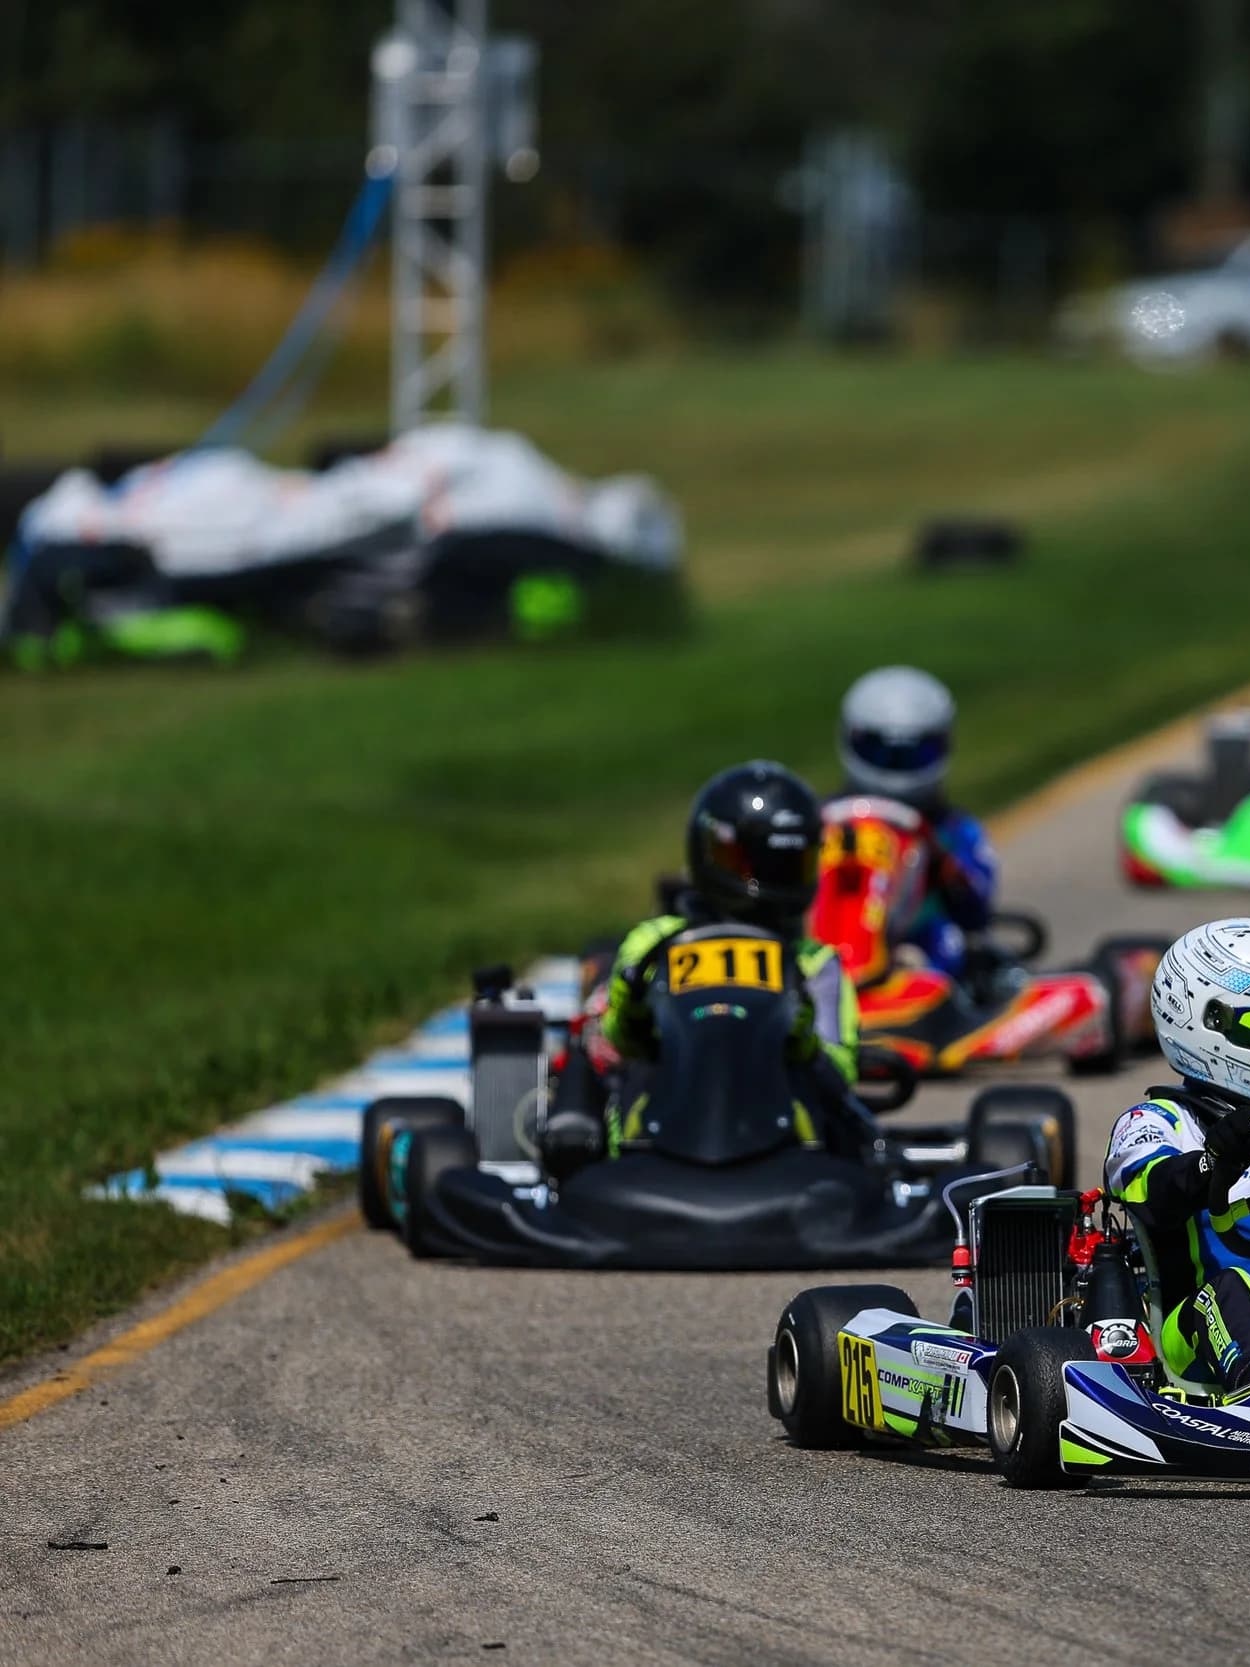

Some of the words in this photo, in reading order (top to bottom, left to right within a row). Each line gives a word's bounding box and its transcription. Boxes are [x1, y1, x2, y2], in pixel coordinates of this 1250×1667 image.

[677, 948, 769, 985] 211
[1167, 995, 1183, 1013] BELL
[1114, 1339, 1138, 1349] BRP
[843, 1336, 875, 1426] 215
[878, 1368, 944, 1405] COMPKART
[1152, 1403, 1232, 1438] COASTAL
